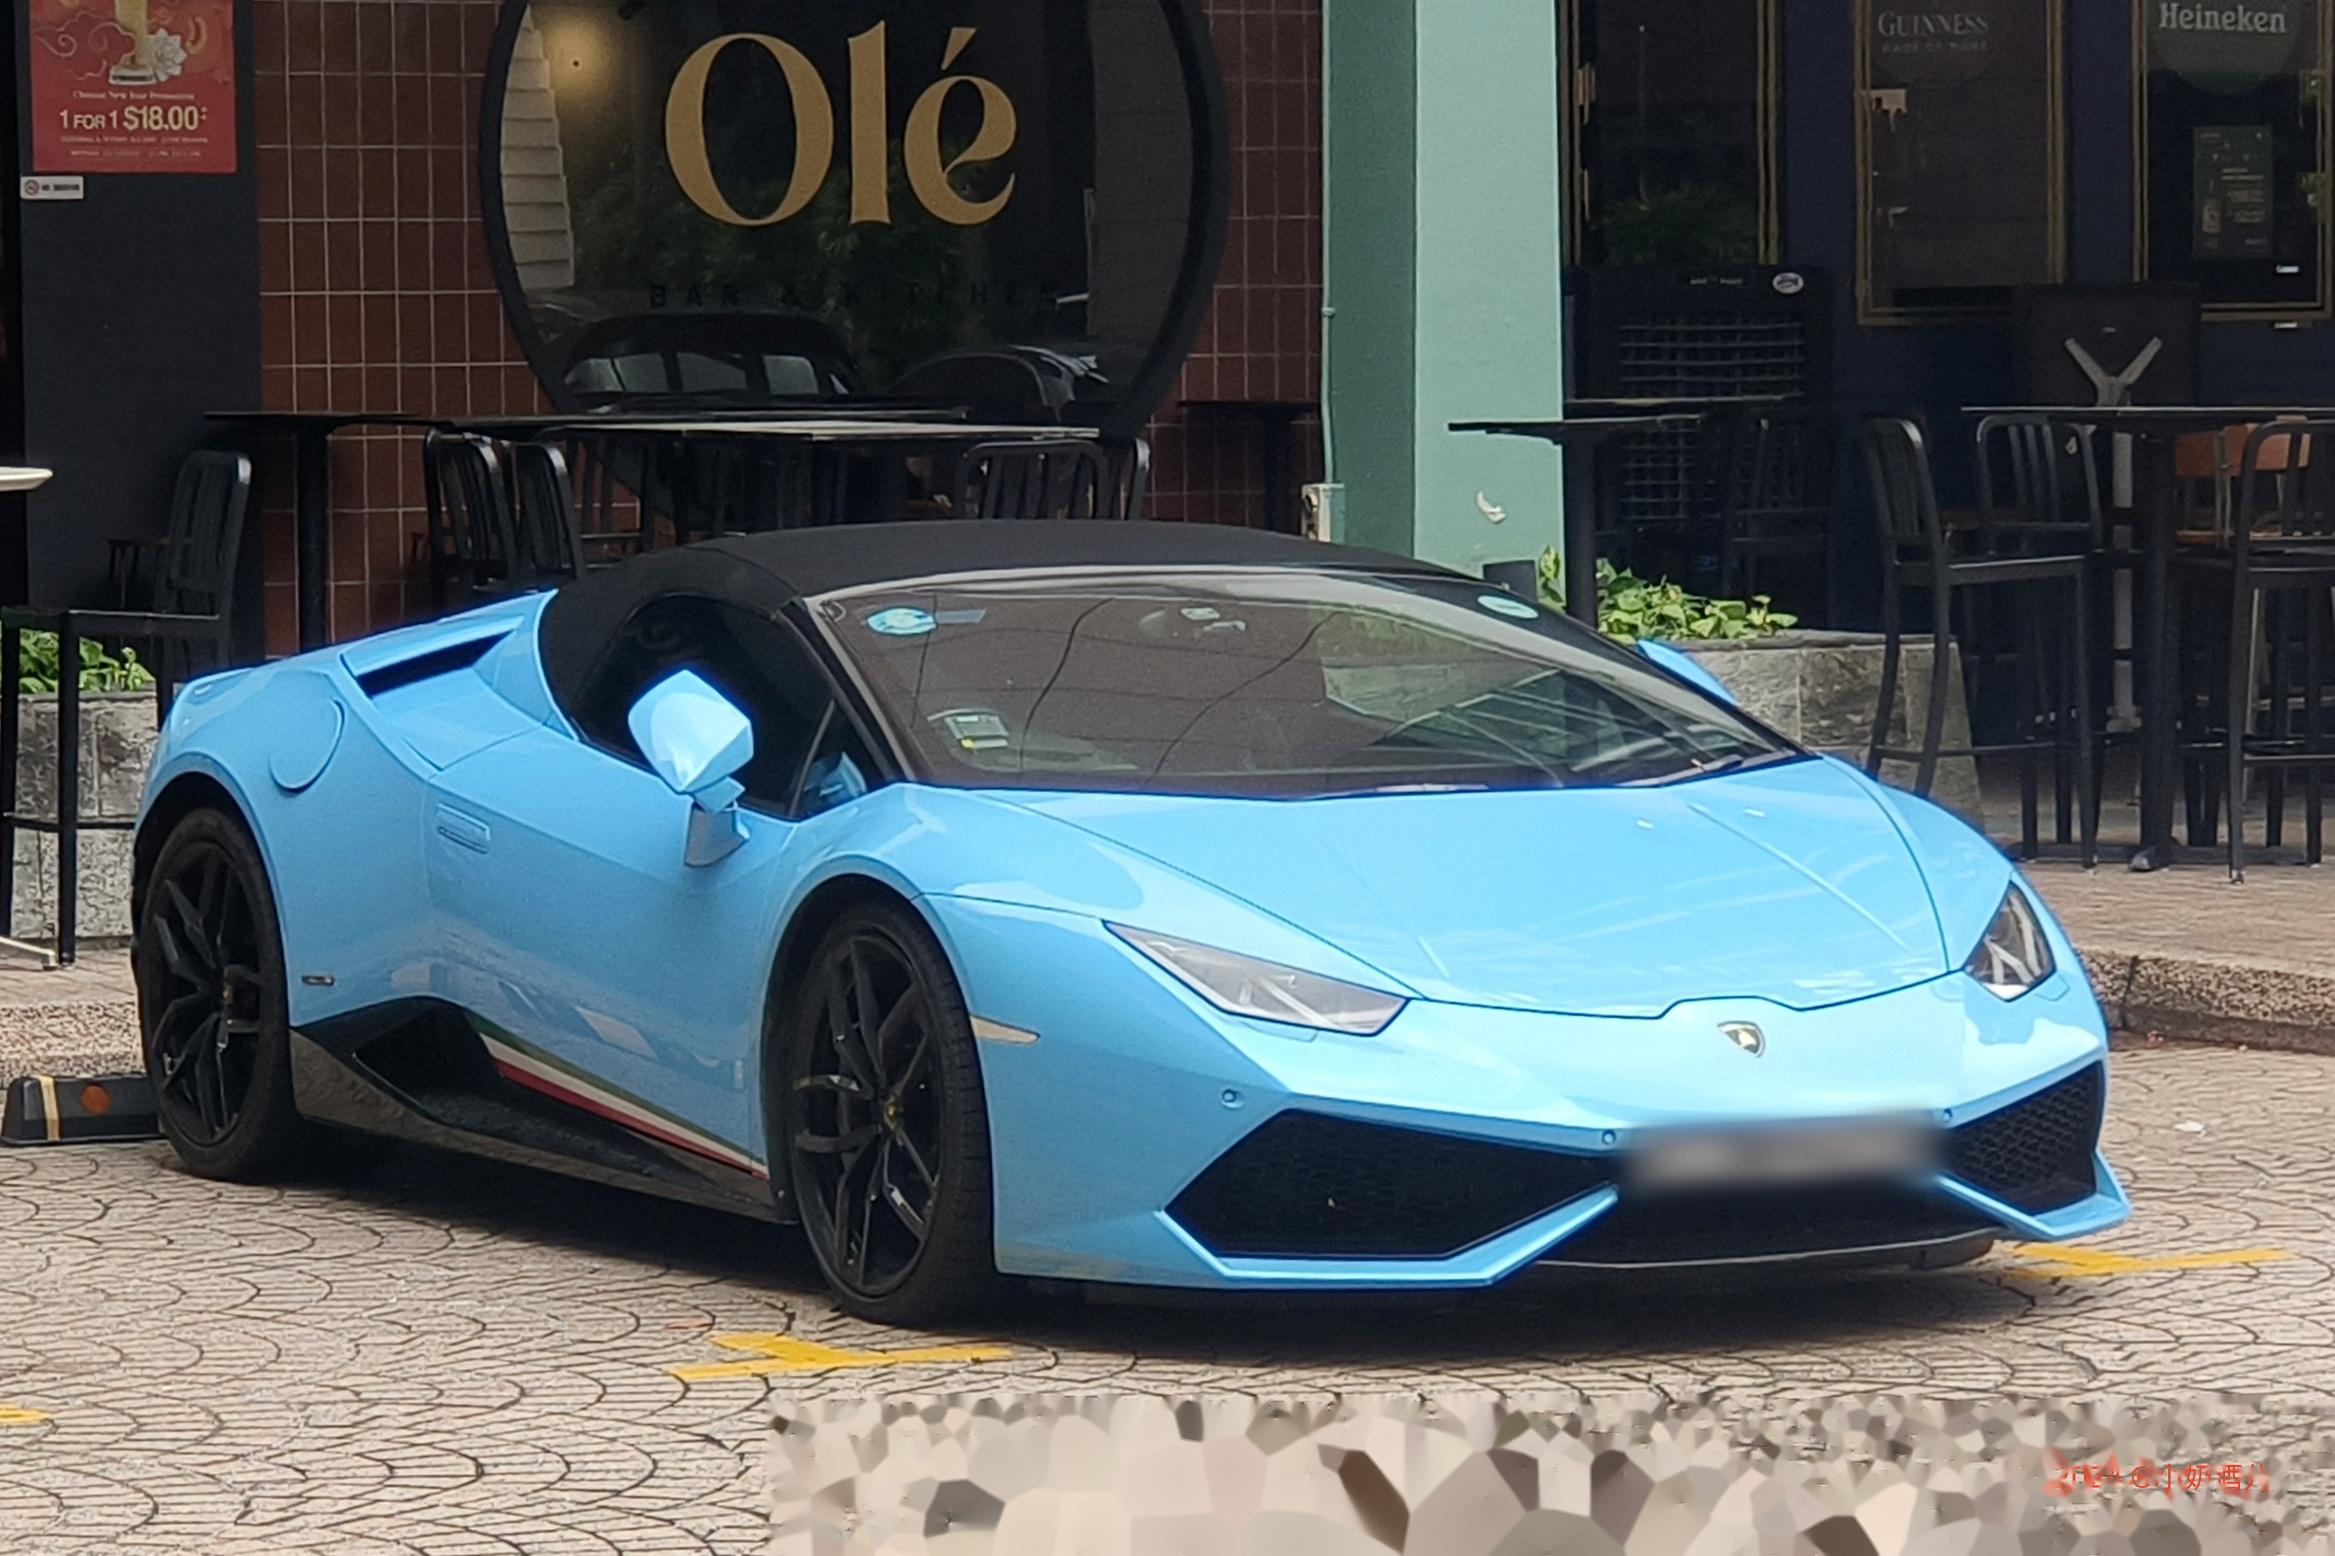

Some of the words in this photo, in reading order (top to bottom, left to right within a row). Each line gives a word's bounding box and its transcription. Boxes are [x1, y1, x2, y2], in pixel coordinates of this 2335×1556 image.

[1878, 12, 1988, 36] GUINNESS
[2159, 2, 2288, 34] Heineken
[60, 109, 69, 129] 1
[74, 114, 105, 130] FOR
[109, 109, 118, 129] 1
[665, 20, 1017, 226] Olé
